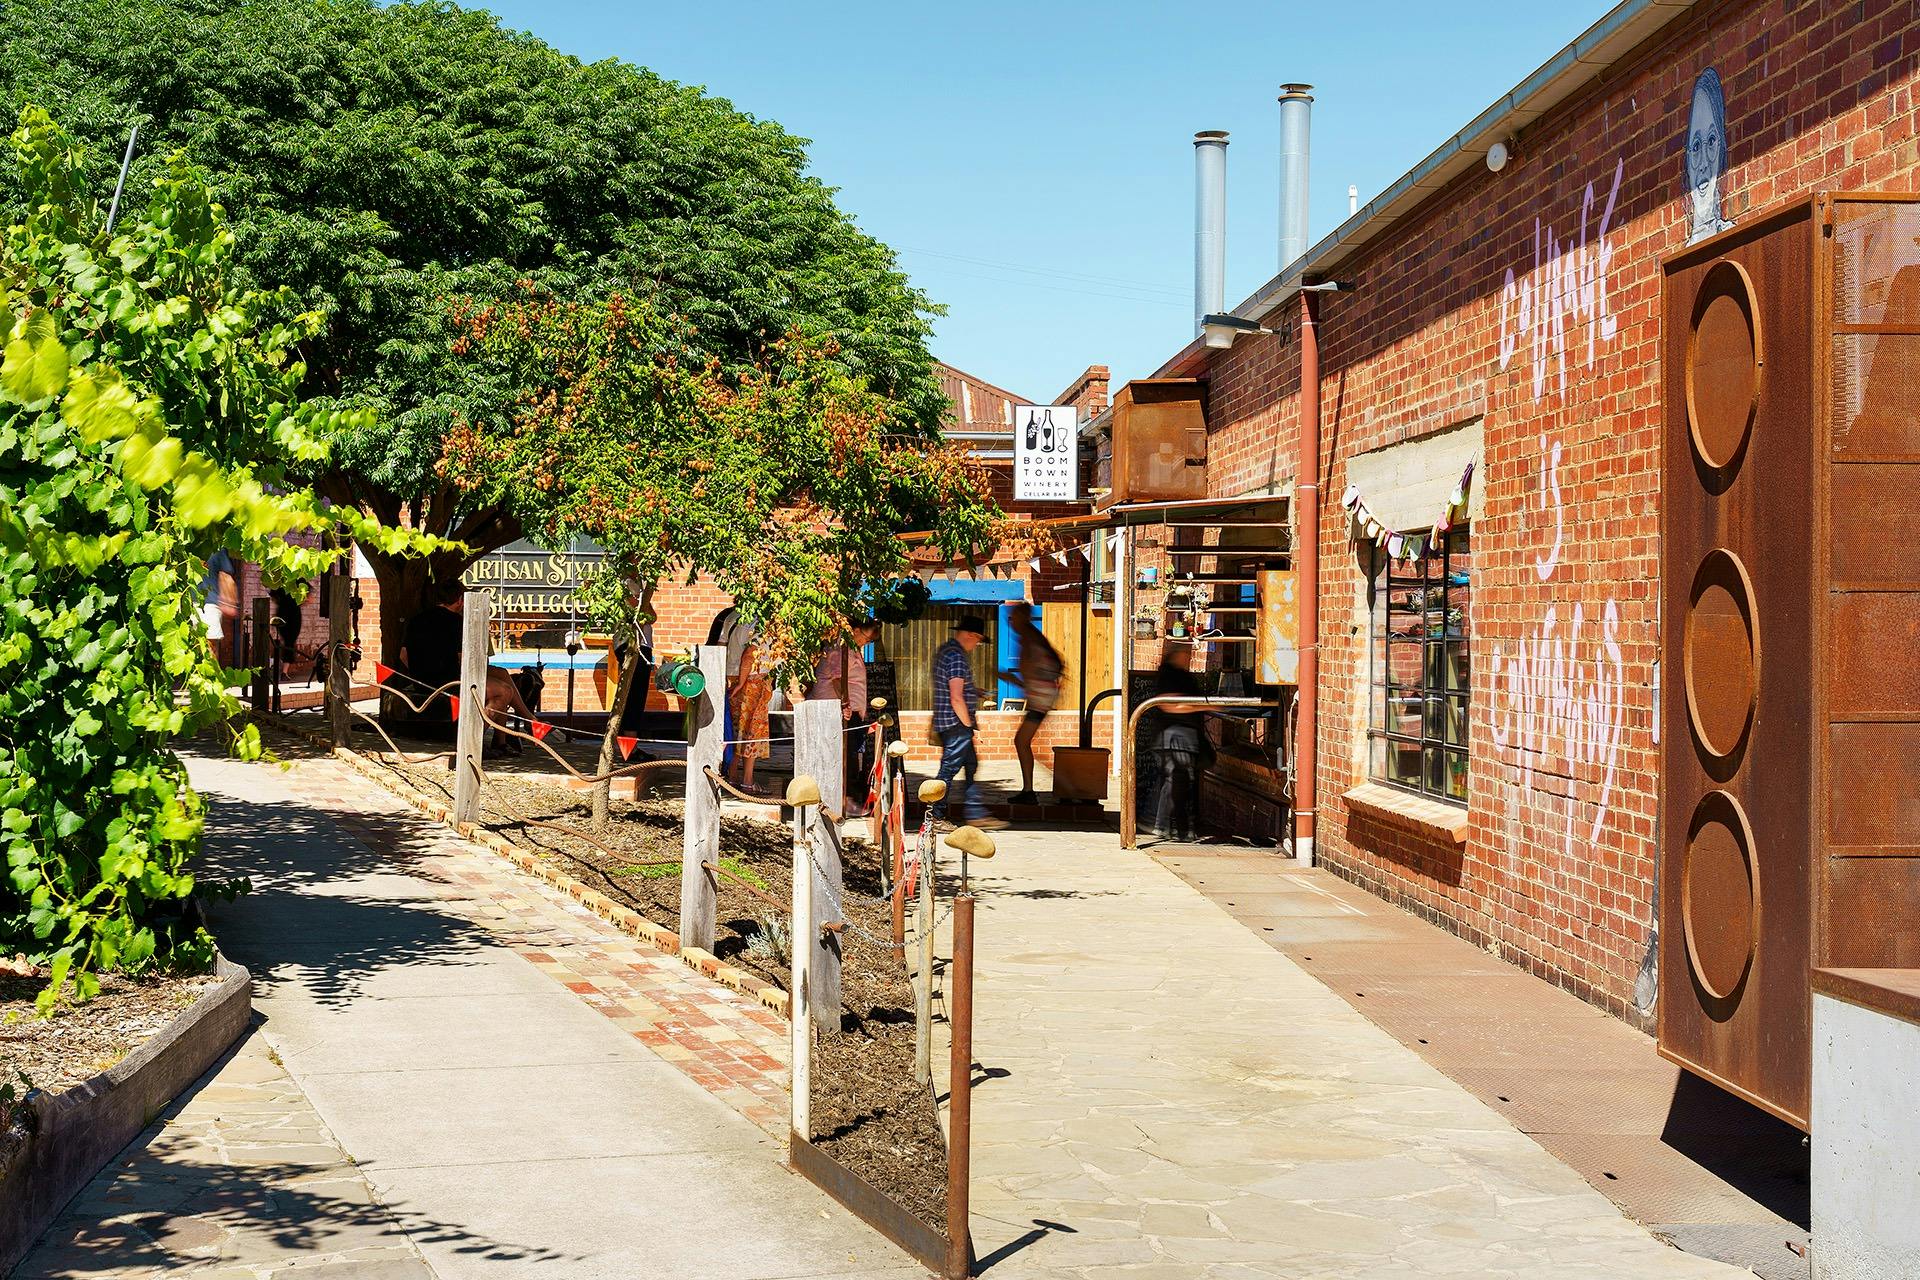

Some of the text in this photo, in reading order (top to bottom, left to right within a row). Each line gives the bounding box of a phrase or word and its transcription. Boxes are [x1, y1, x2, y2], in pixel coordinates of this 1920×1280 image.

[1023, 456, 1068, 465] BOOM
[1023, 468, 1068, 477] TOWN
[458, 560, 544, 589] ARTISAN
